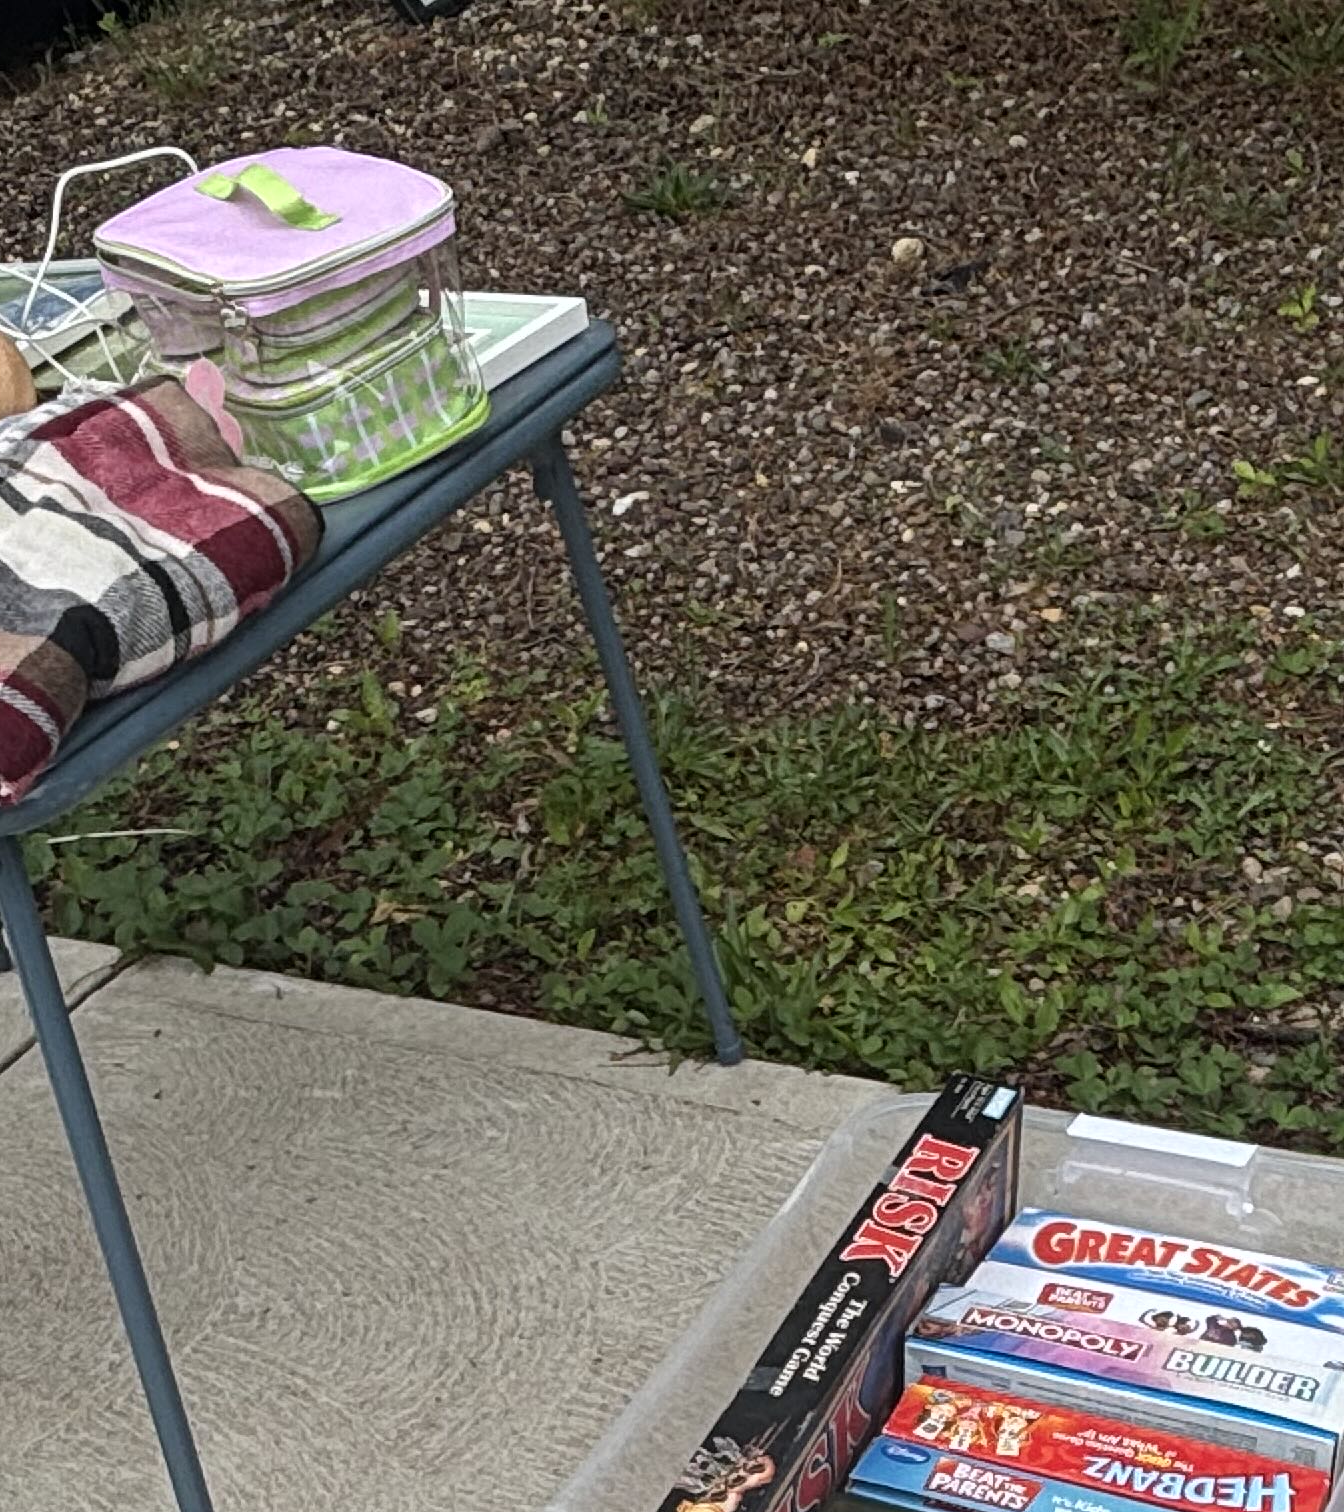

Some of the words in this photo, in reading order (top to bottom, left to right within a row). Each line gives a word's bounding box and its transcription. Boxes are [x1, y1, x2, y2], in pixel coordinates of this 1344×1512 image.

[839, 1133, 980, 1277] RISK
[1033, 1222, 1187, 1267] GREAT
[1183, 1248, 1321, 1308] STATES
[802, 1271, 861, 1345] Conquest
[846, 1299, 867, 1331] The
[966, 1308, 1140, 1359] MONOPOLY
[769, 1346, 811, 1397] Game
[803, 1331, 848, 1382] World
[1165, 1348, 1320, 1401] BUILDER
[930, 1474, 1029, 1512] PARENTS
[952, 1462, 1005, 1489] BEAT
